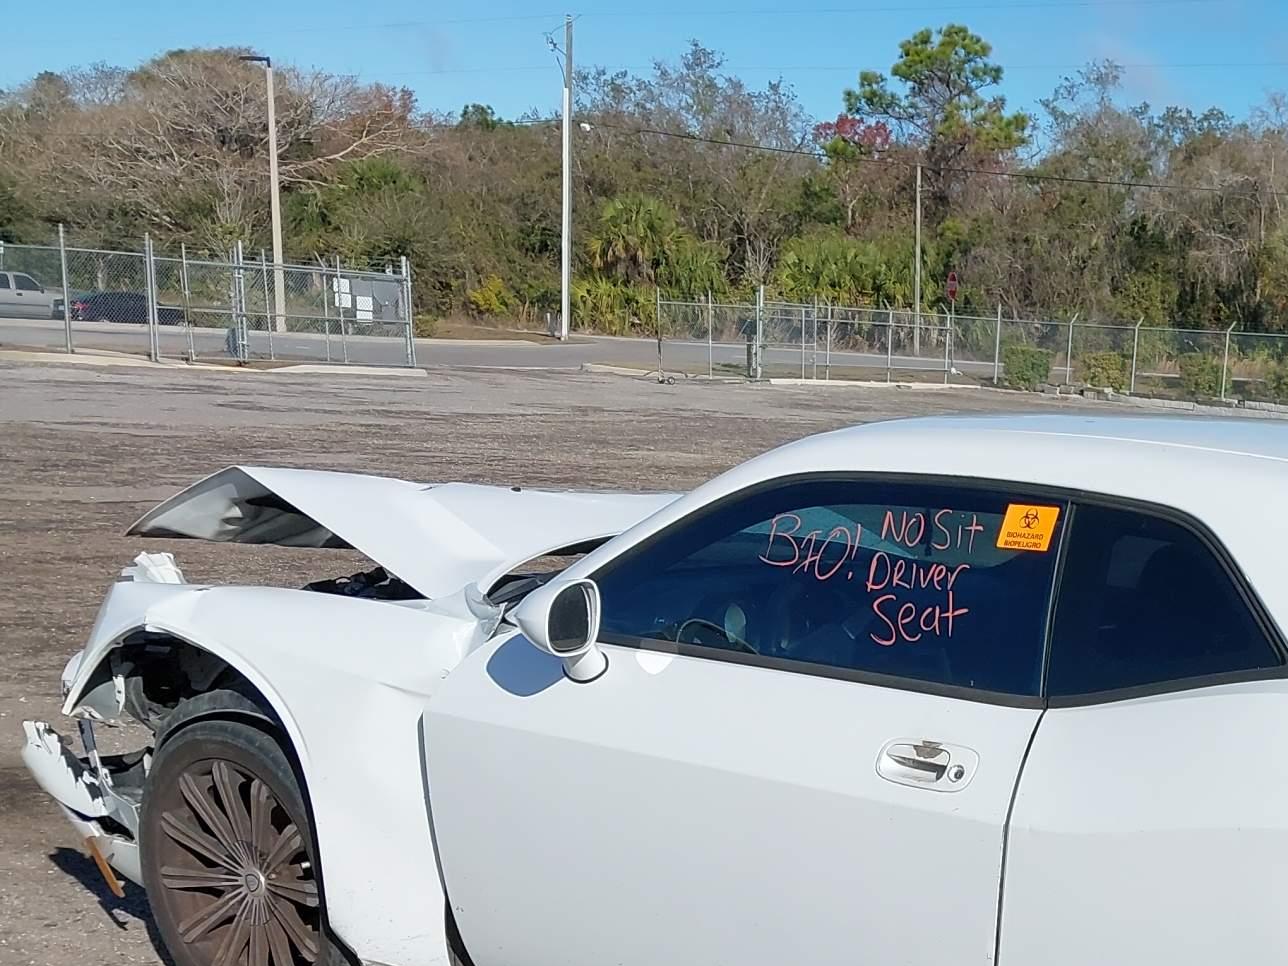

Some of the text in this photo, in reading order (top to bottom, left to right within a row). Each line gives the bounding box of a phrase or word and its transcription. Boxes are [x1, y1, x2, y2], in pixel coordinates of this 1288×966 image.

[881, 509, 984, 553] NO Sit
[870, 590, 969, 646] Seat
